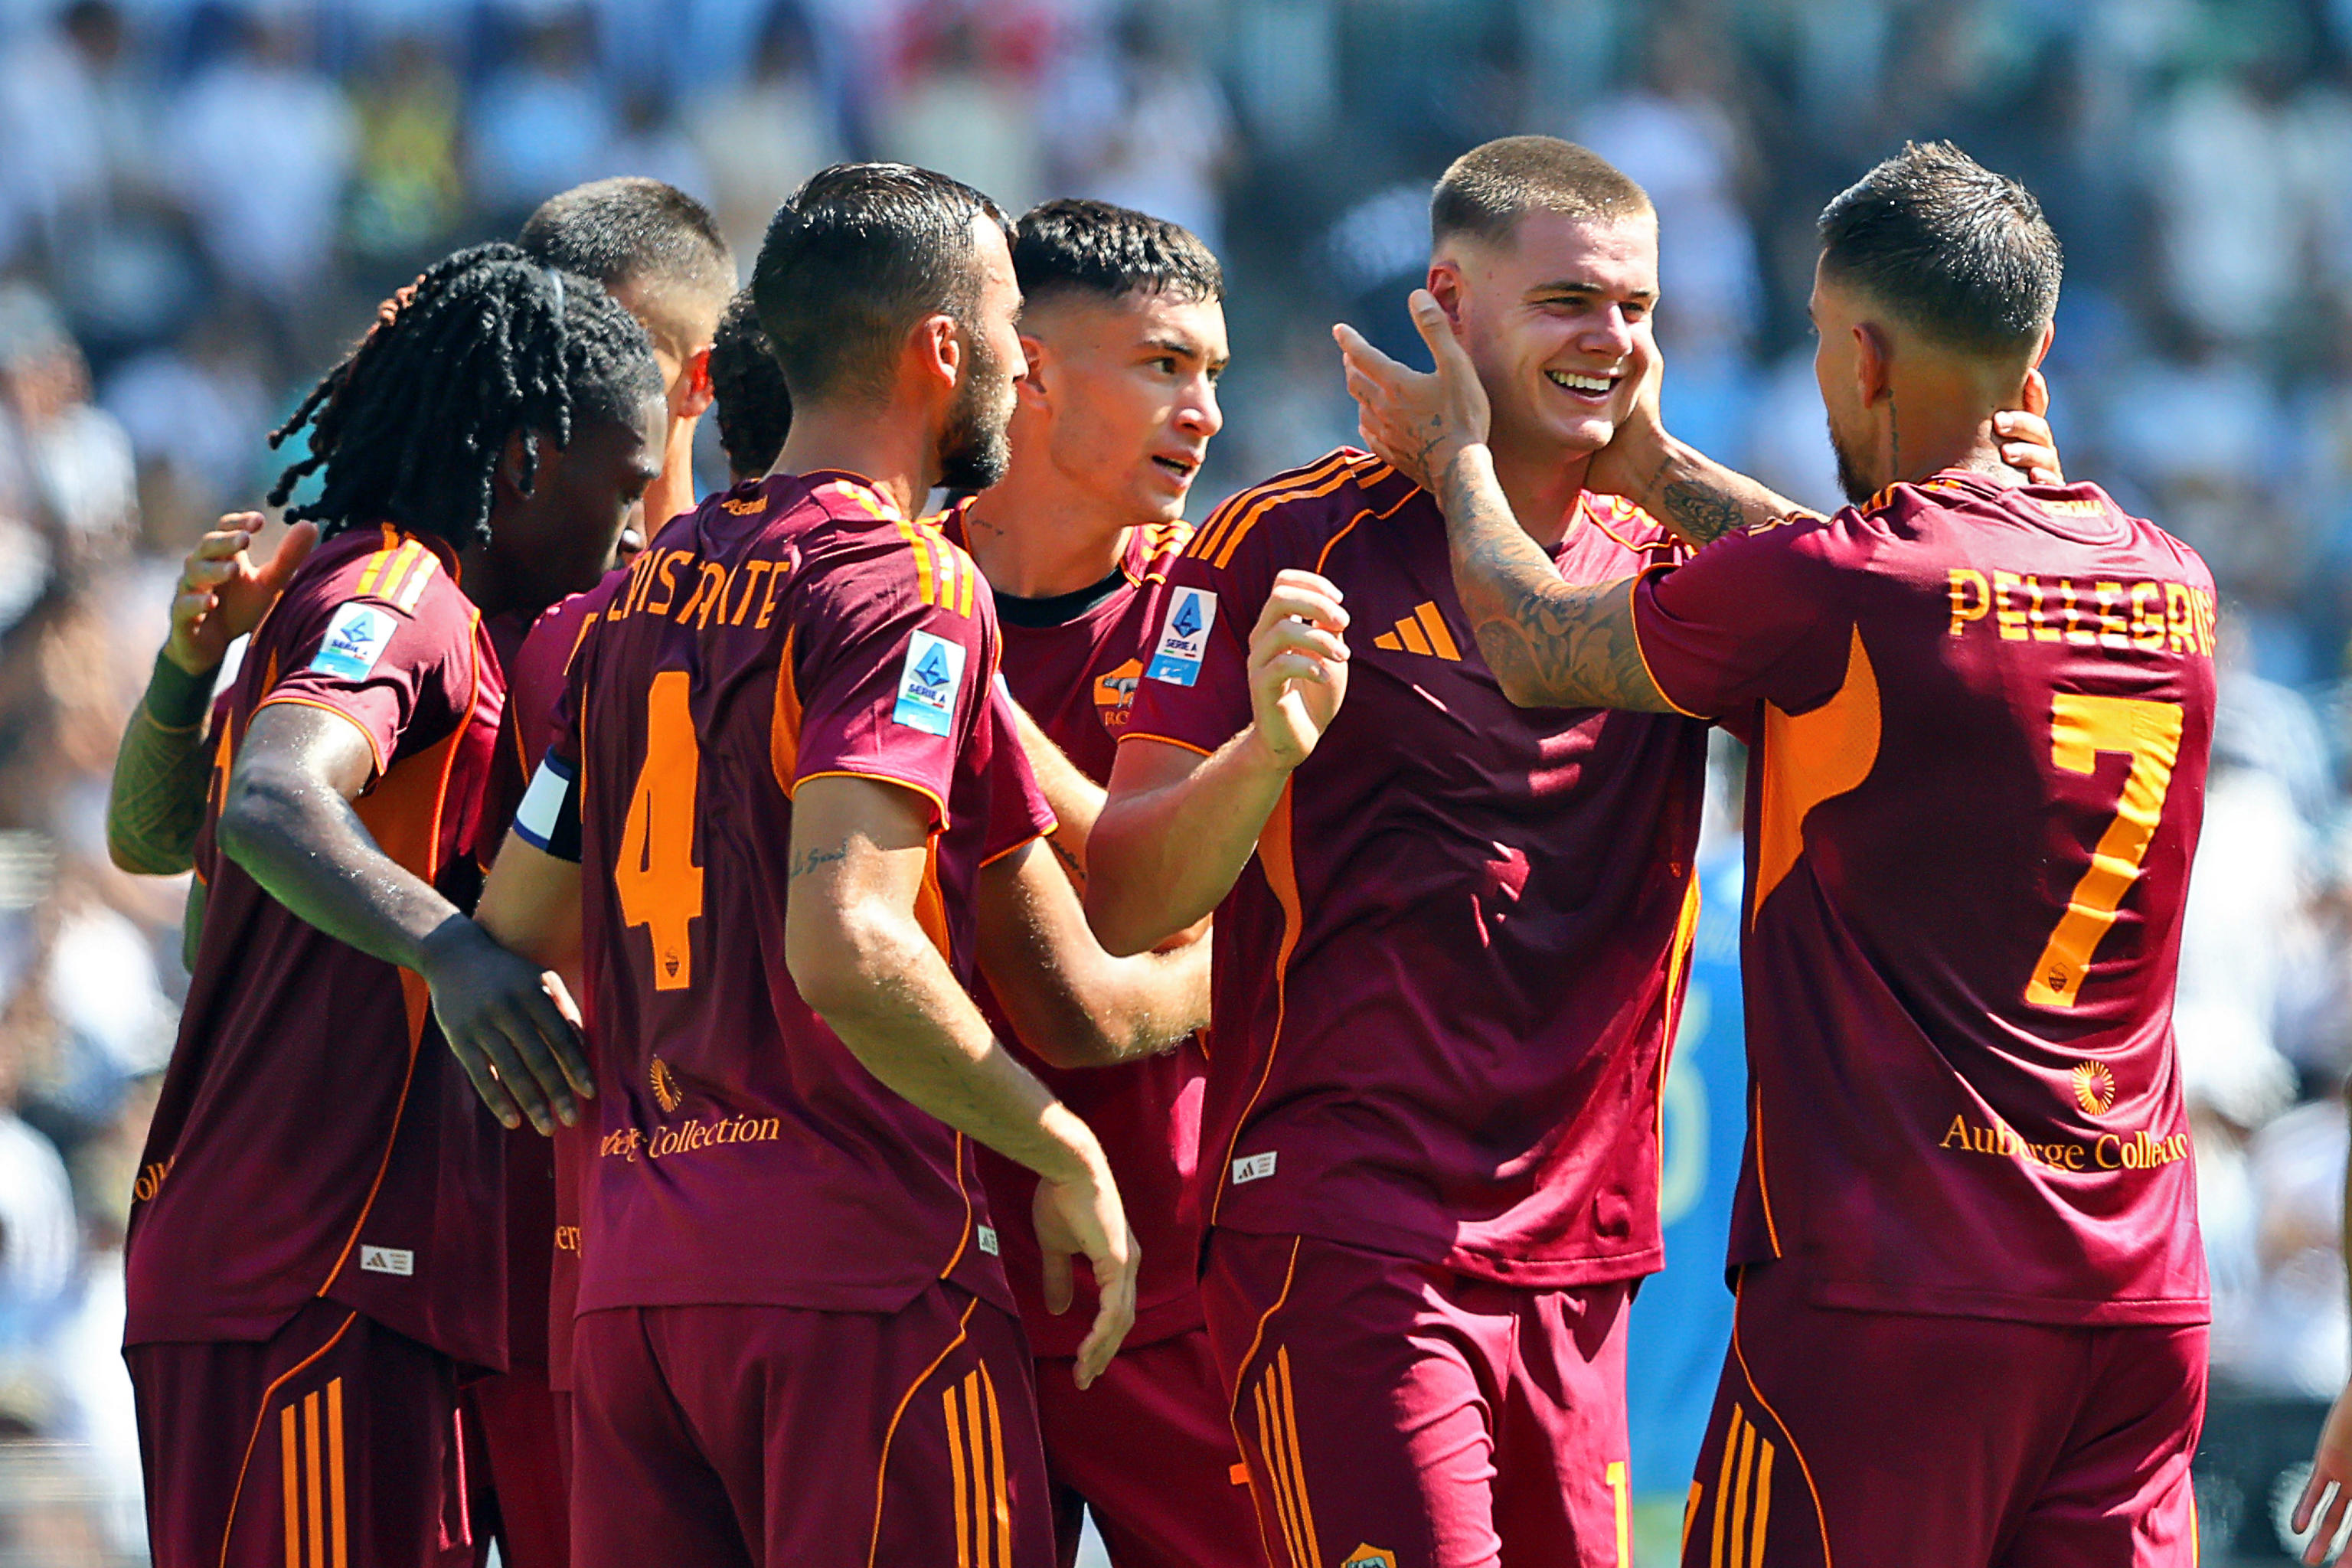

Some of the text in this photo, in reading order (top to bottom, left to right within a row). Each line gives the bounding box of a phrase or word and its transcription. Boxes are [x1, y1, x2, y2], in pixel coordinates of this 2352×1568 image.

[1165, 639, 1197, 651] SERIE A
[909, 684, 946, 704] SERIE A
[614, 671, 704, 991] 4
[2025, 692, 2184, 1008] 7
[648, 1114, 781, 1158] Collection
[1938, 1114, 2086, 1175] Auberge
